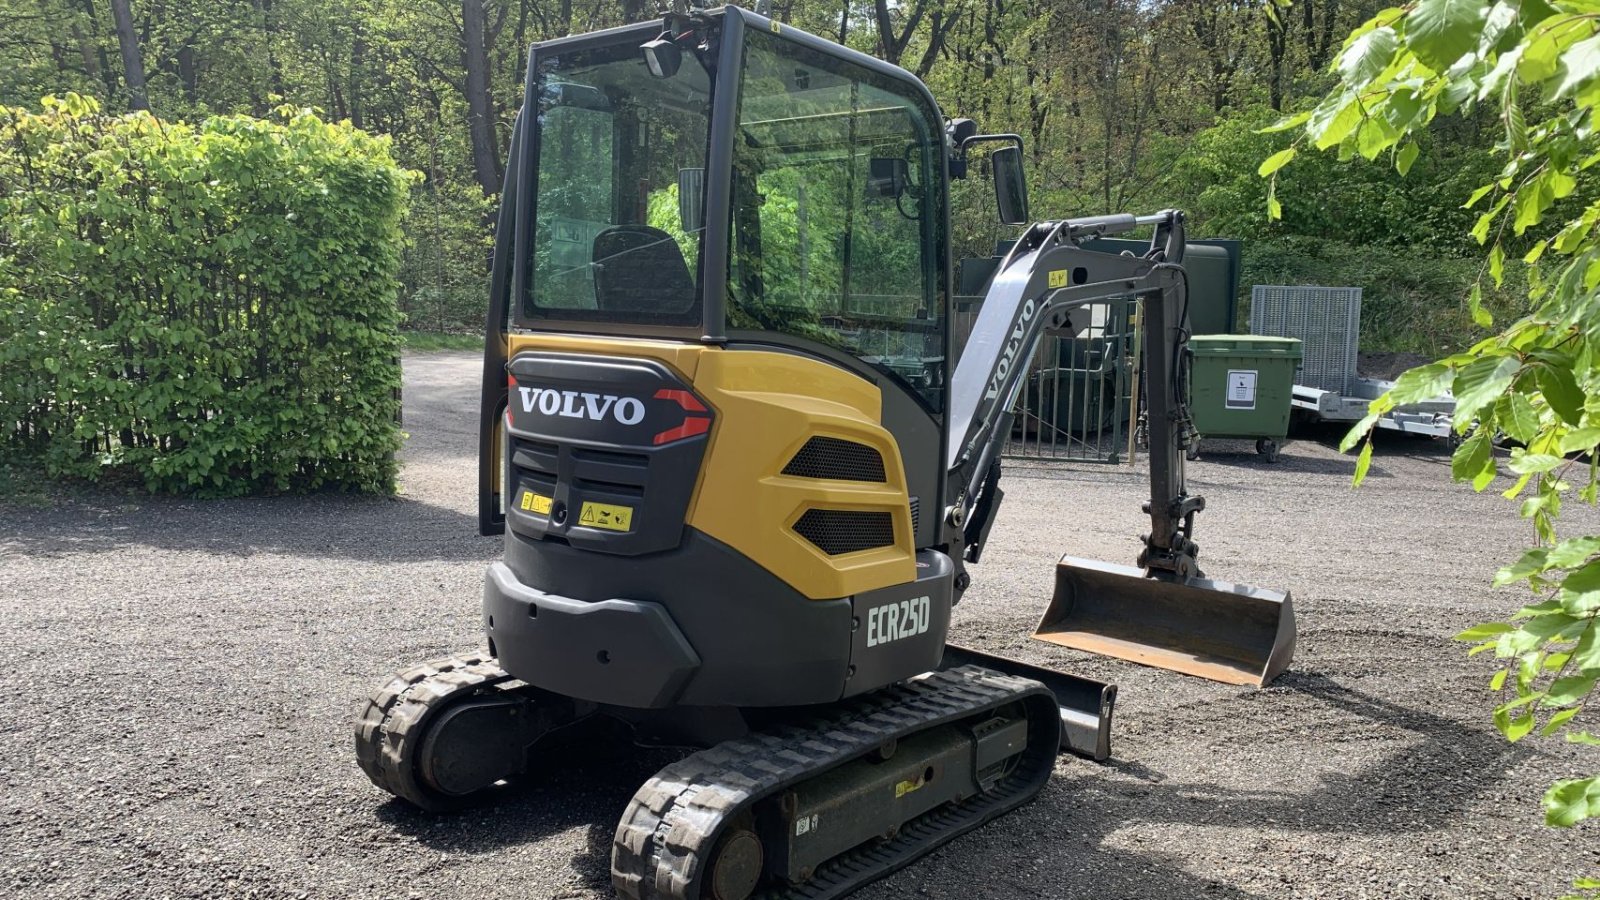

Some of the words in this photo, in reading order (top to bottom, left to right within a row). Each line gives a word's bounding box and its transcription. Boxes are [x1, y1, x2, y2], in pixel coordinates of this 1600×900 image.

[984, 299, 1034, 400] VOLVO
[518, 386, 645, 425] VOLVO
[867, 596, 930, 647] ECR25D
